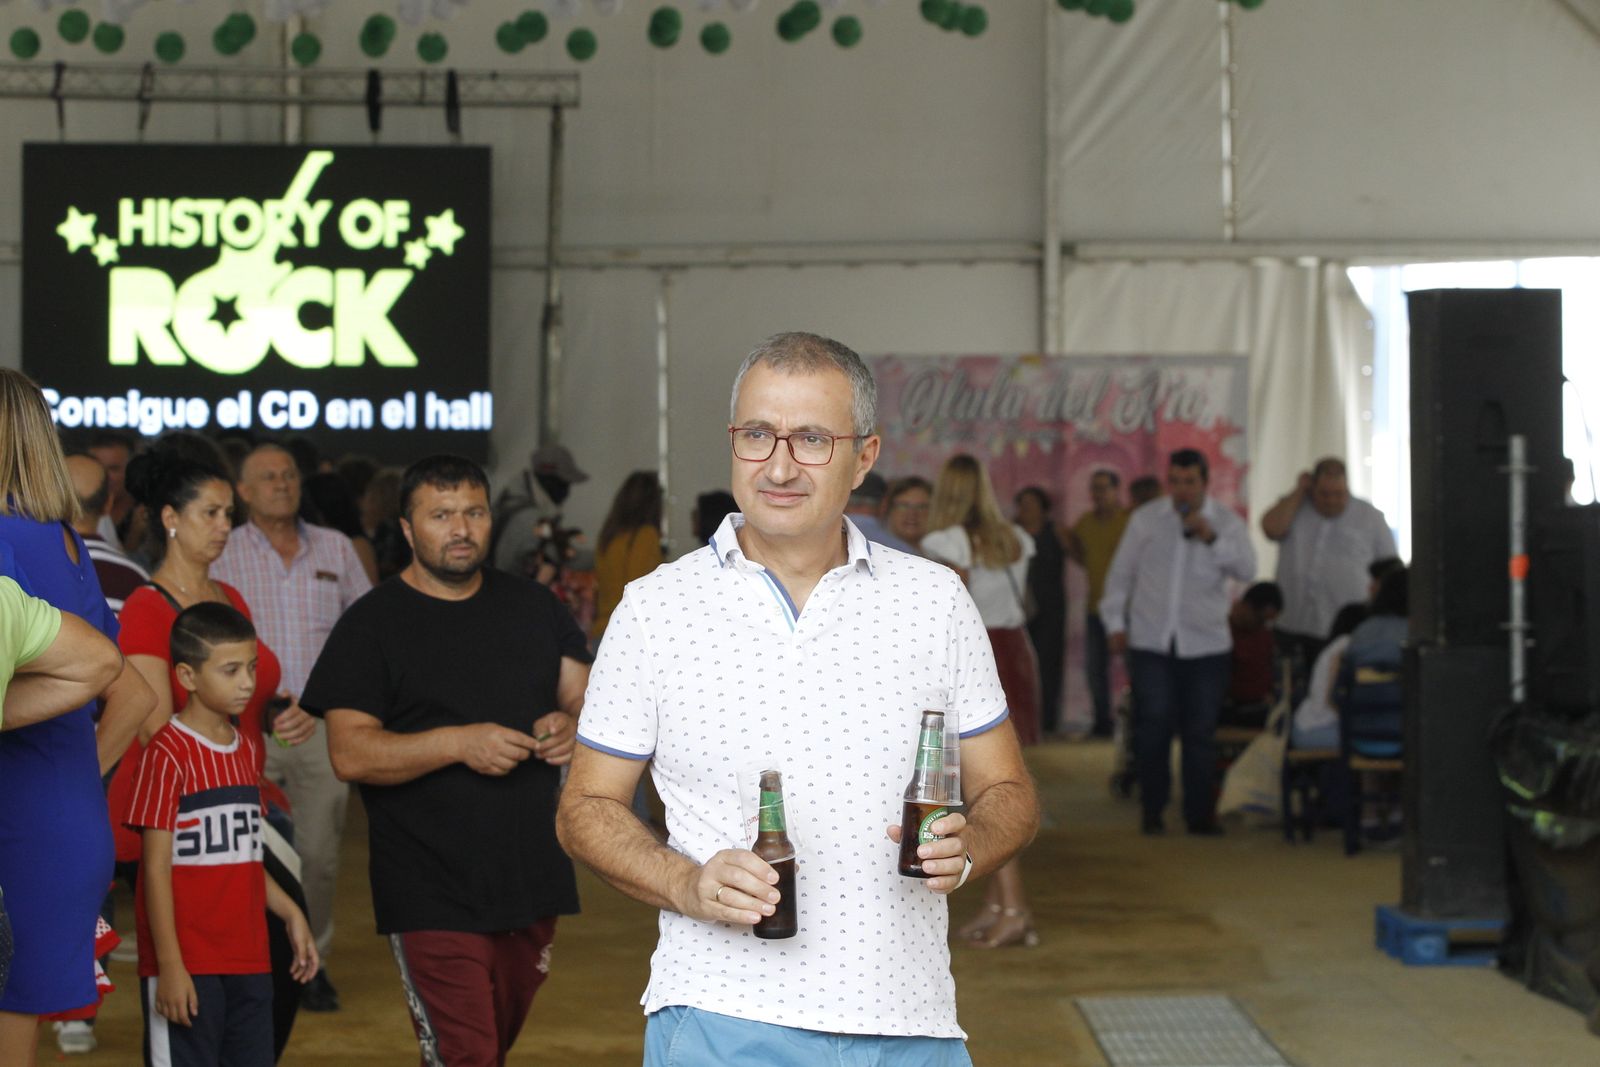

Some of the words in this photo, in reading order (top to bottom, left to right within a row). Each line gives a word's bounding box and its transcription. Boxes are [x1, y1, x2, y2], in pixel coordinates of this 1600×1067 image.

[118, 197, 333, 250] HISTORY
[338, 198, 410, 249] OF
[109, 265, 419, 375] ROCK
[216, 389, 251, 429] el
[258, 390, 319, 430] CD
[325, 397, 374, 430] en
[381, 390, 416, 430] el
[425, 390, 493, 431] hall
